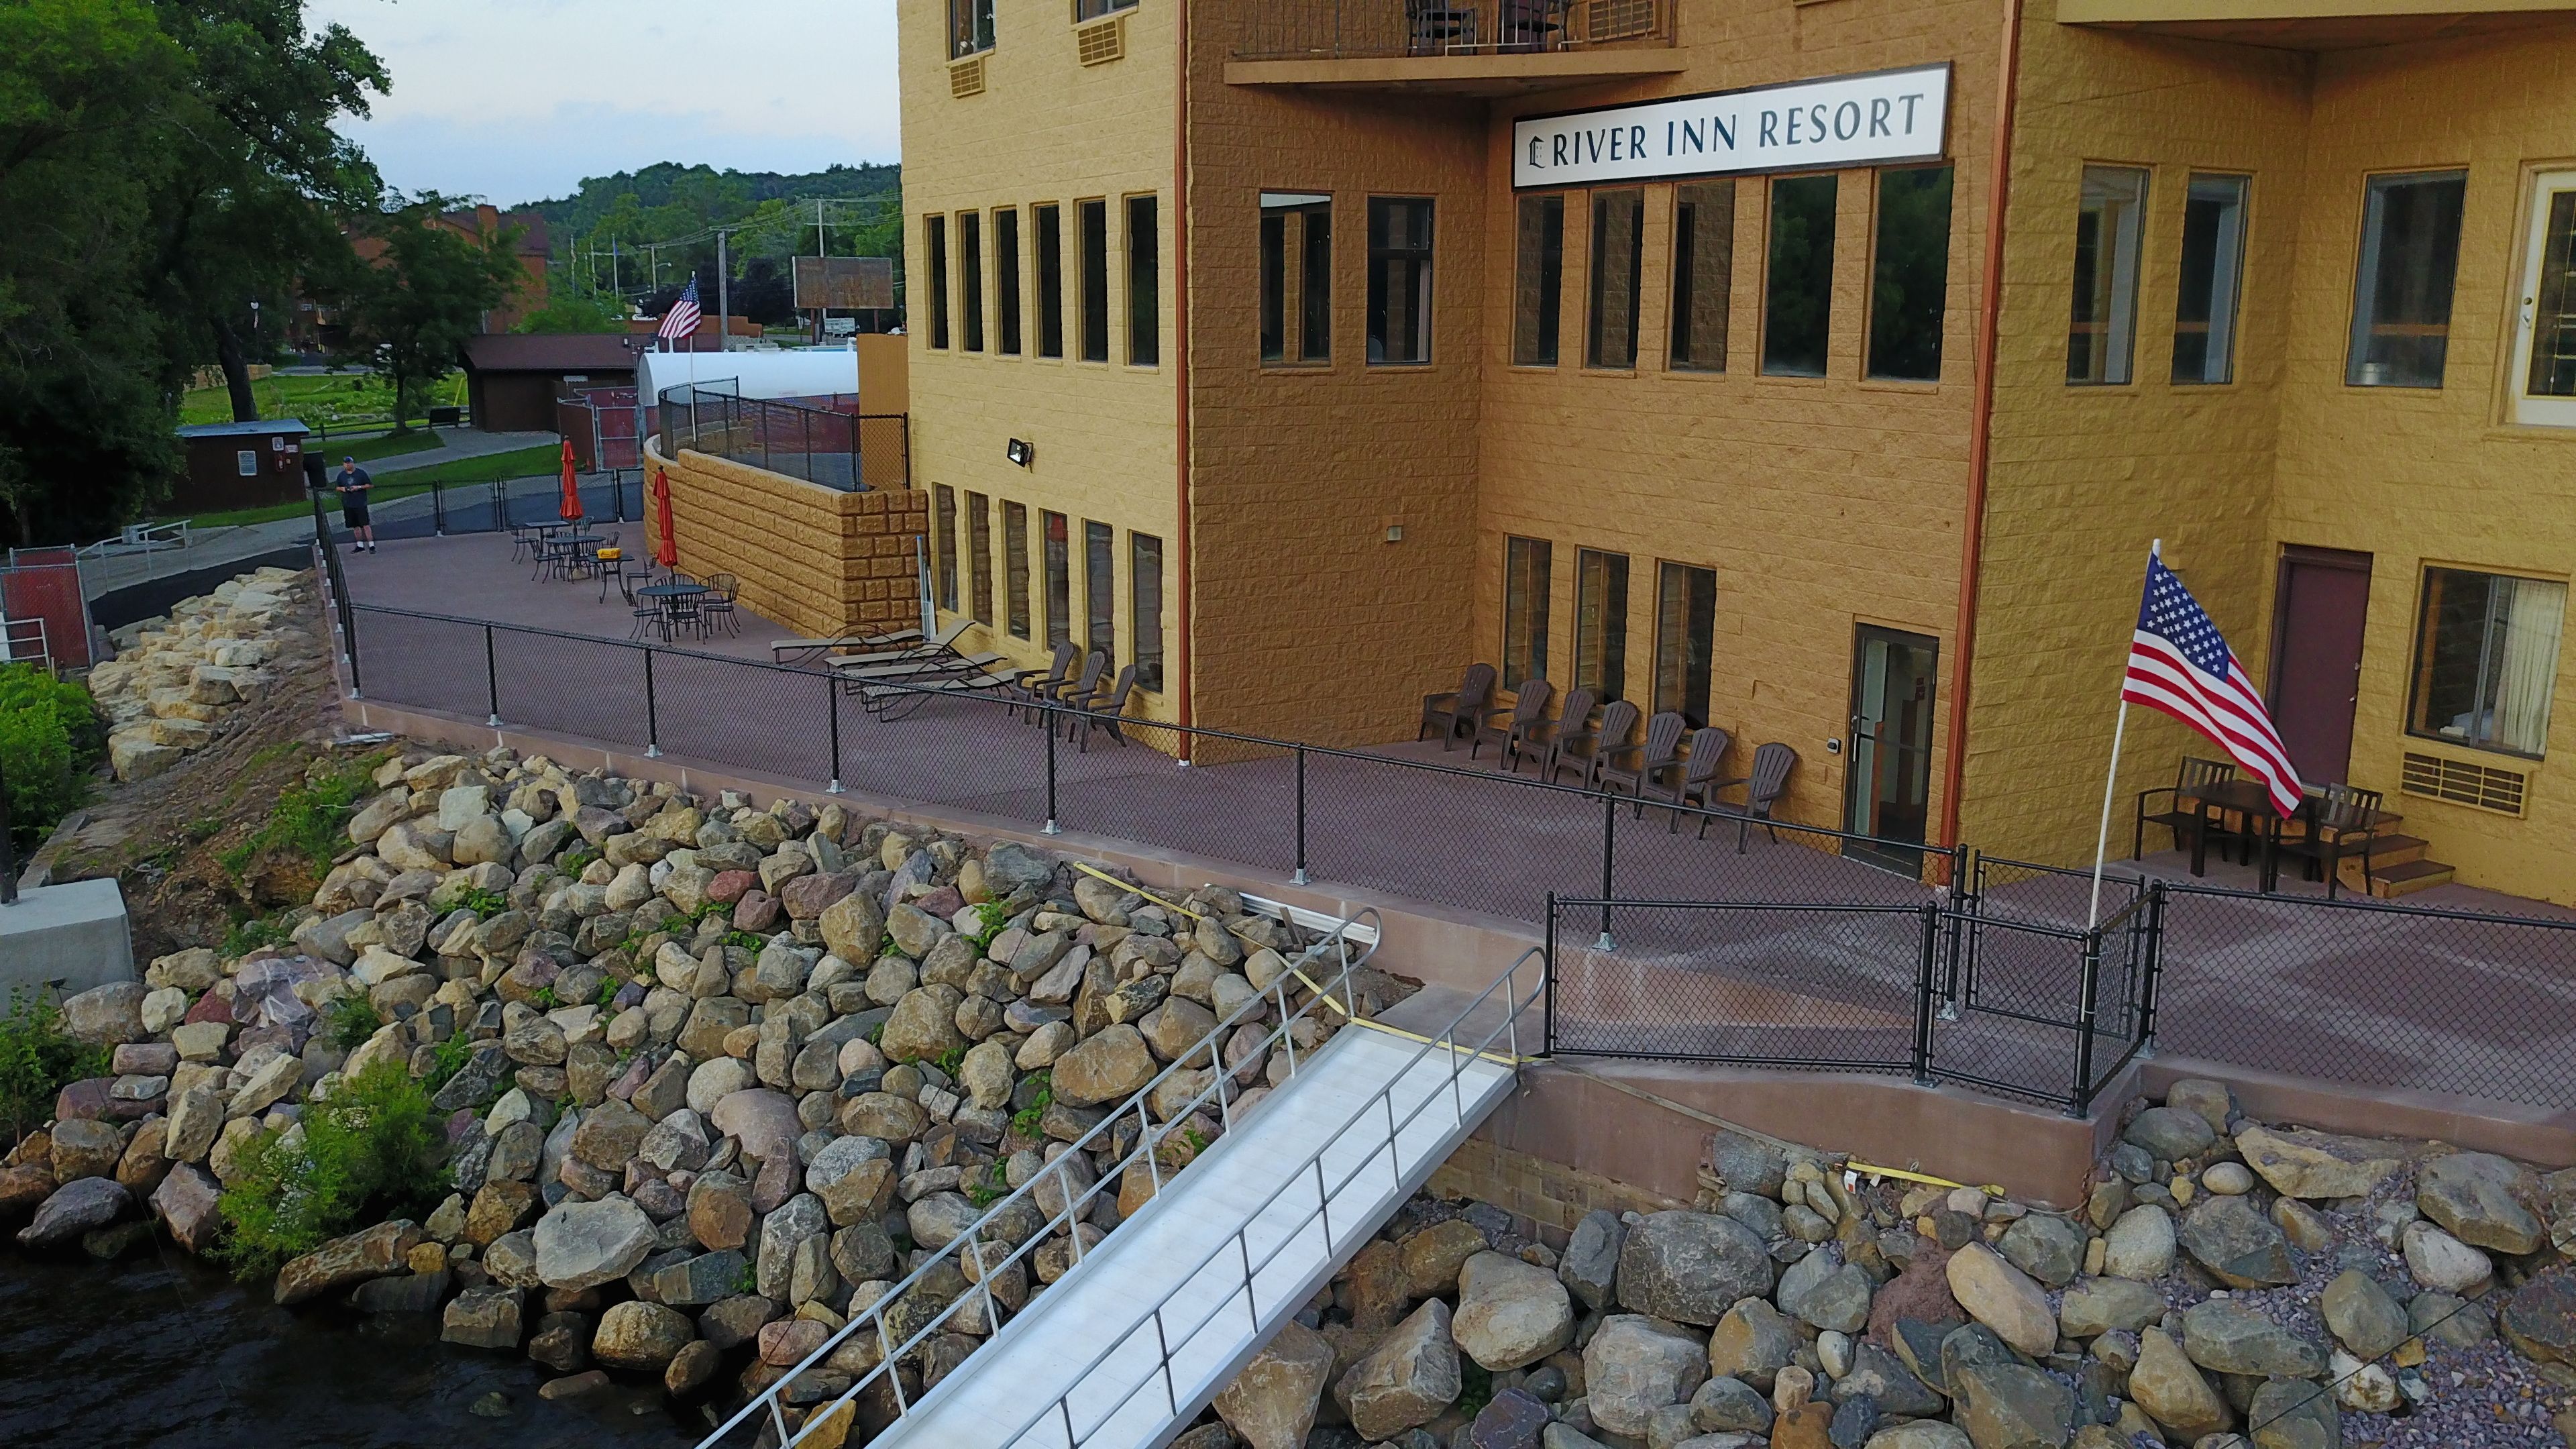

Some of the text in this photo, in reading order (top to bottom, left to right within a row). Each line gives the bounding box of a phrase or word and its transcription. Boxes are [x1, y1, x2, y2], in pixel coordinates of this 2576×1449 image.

[1552, 93, 1924, 166] RIVER INN RESORT
